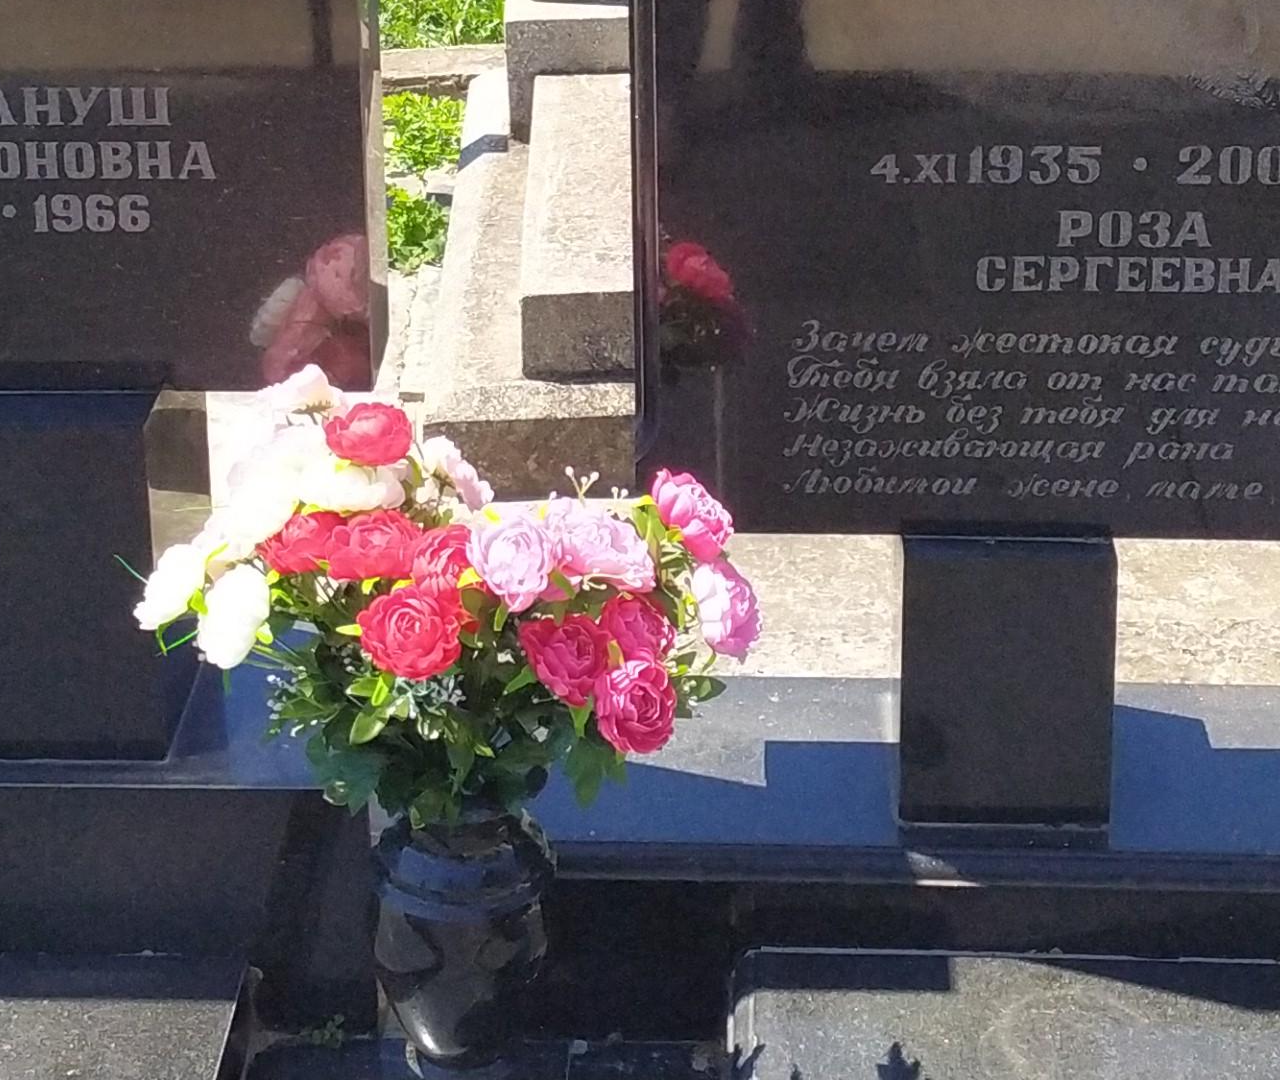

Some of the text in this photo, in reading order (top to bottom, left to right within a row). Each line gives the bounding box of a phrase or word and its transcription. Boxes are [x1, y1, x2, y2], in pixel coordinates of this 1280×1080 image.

[33, 194, 151, 233] 1966
[1056, 209, 1213, 249] РОЗА
[792, 320, 929, 353] Зачем
[951, 327, 1178, 358] жестокая
[786, 355, 902, 392] Тебя
[1047, 371, 1103, 392] от
[1124, 372, 1198, 393] нас
[783, 394, 926, 436] Жизнь
[946, 393, 1005, 436] без
[1020, 394, 1126, 428] тебя
[1146, 407, 1221, 436] для
[1123, 440, 1236, 470] рана
